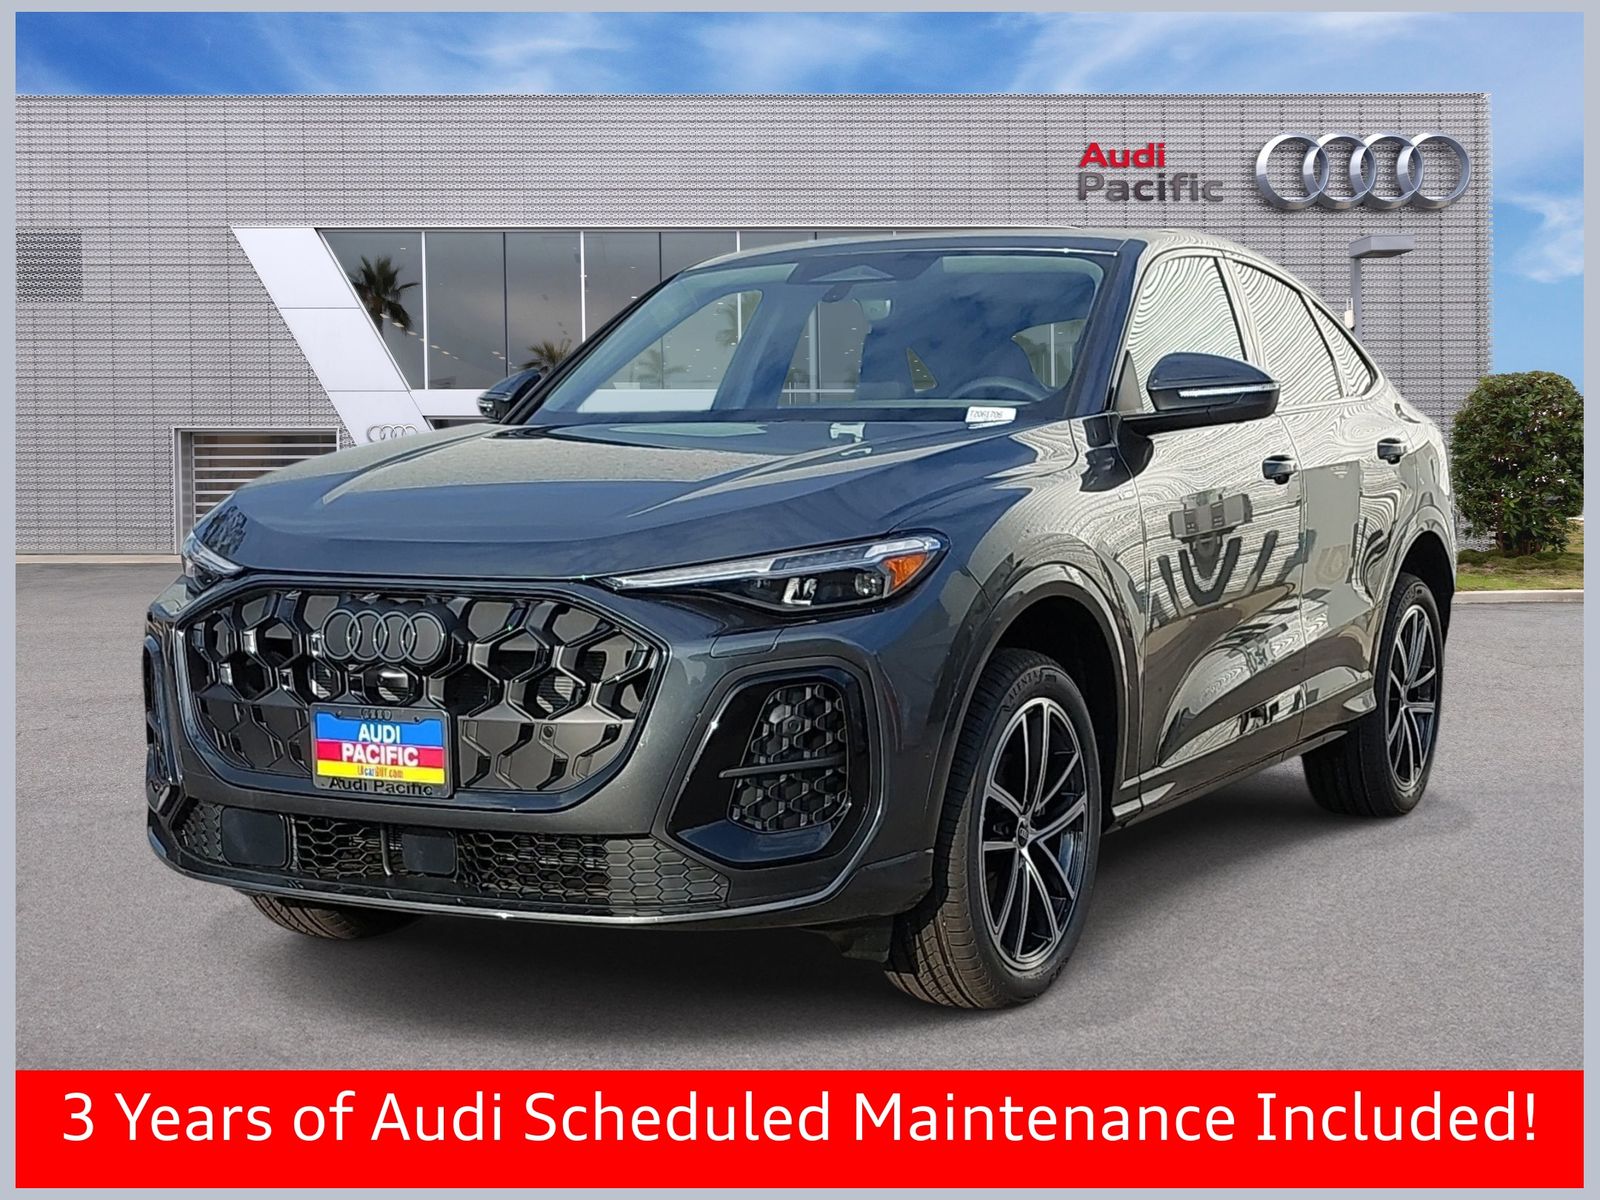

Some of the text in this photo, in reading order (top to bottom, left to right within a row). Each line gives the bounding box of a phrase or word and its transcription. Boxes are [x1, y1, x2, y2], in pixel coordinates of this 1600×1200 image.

[1079, 142, 1165, 168] Audi
[1078, 172, 1224, 202] Pacific
[358, 723, 401, 744] AUDI
[341, 742, 419, 767] PACIFIC
[329, 777, 433, 796] Audi Pacific
